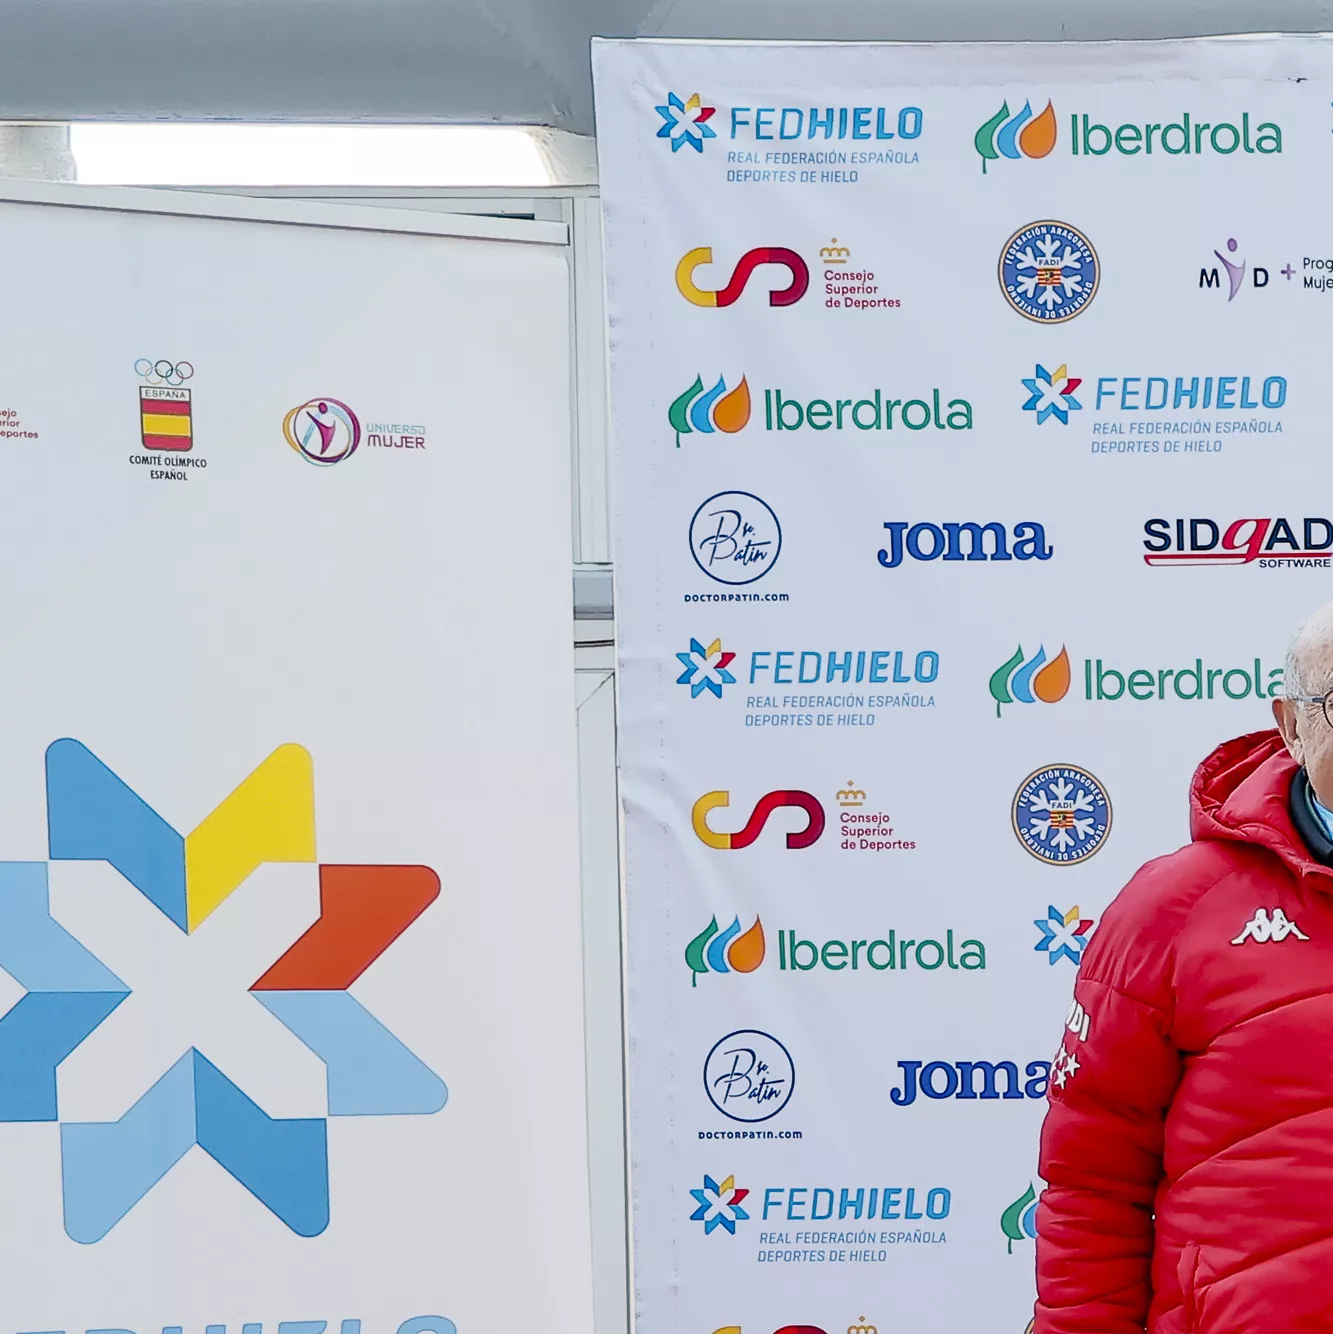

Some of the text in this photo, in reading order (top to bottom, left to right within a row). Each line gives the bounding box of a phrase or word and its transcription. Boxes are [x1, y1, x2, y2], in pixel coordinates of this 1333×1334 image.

[731, 107, 923, 140] FEDHIELO
[1071, 112, 1282, 155] Iberdrola
[728, 150, 919, 164] REAL FEDERACIÓN ESPAÑOLA
[727, 170, 857, 182] DEPORTES DE HIELO
[824, 270, 875, 286] Consejo
[826, 284, 878, 296] Superior
[826, 297, 900, 310] de Deportes
[145, 388, 186, 400] ESPAÑA
[765, 389, 972, 430] Iberdrola
[366, 423, 426, 435] UNIVERSO
[368, 435, 425, 449] MUJER
[129, 455, 206, 467] COMITÉ OLÍMPICO
[151, 470, 187, 480] ESPAÑOL
[1259, 559, 1332, 568] SOFTWARE
